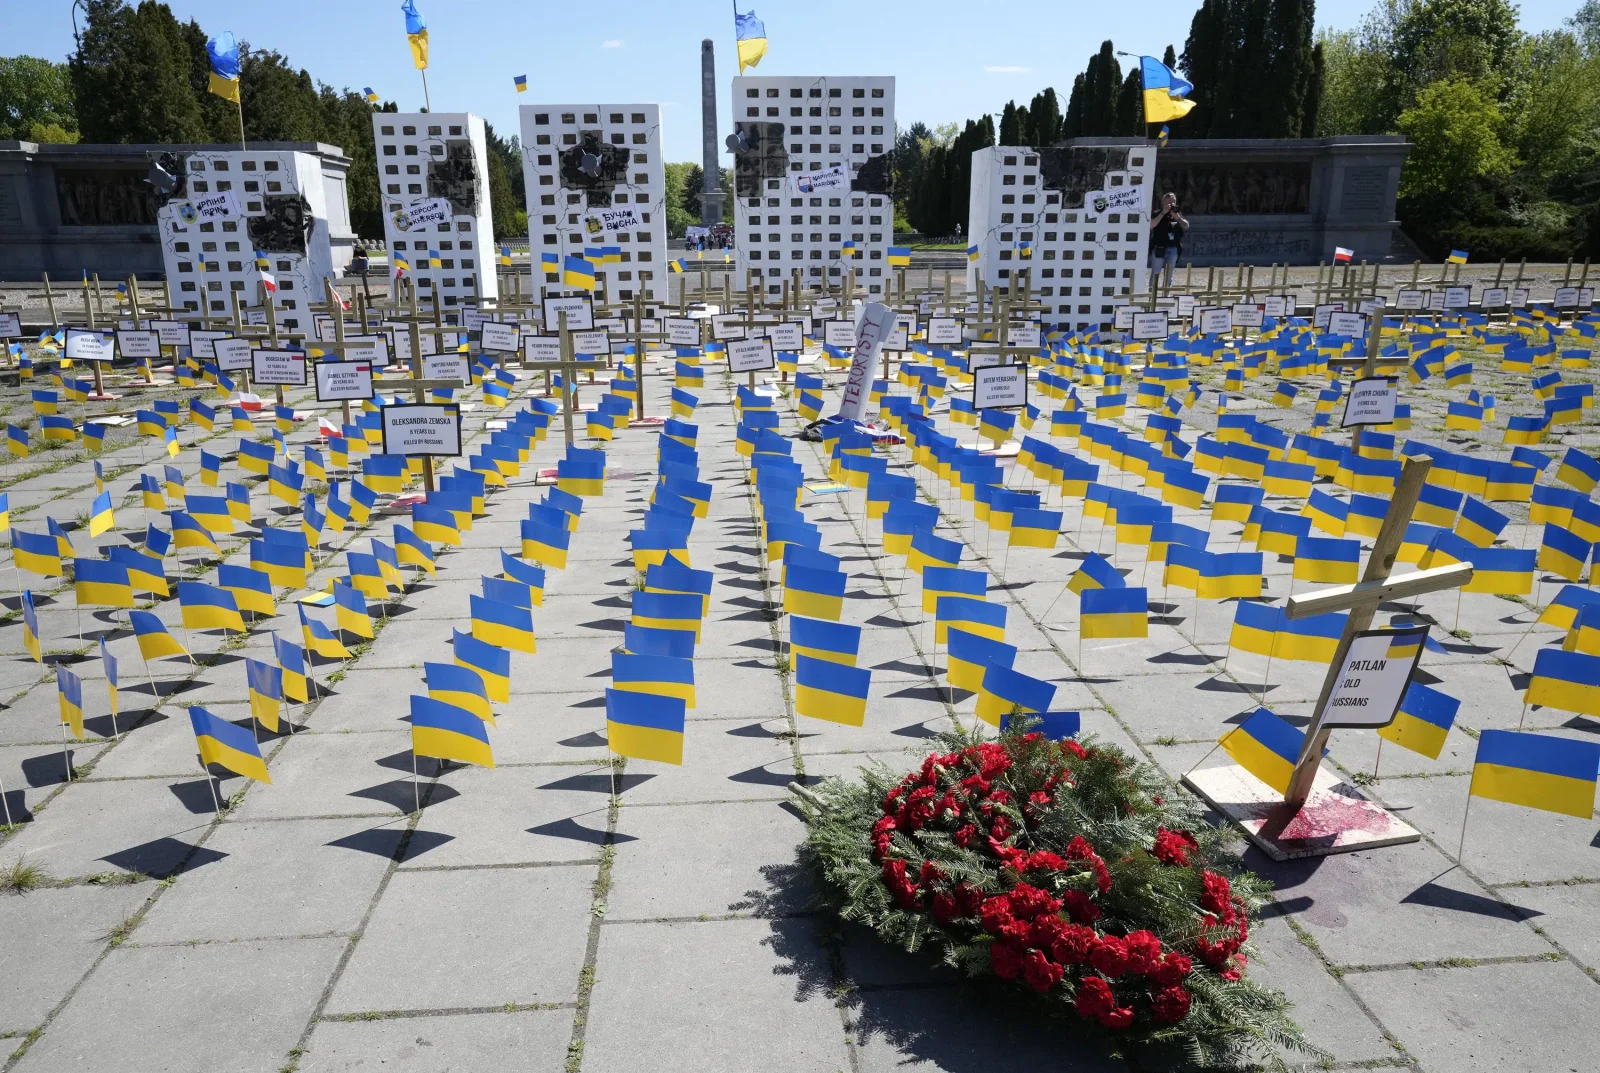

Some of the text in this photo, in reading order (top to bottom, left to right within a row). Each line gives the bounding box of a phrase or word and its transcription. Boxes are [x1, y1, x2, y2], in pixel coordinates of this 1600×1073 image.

[1109, 191, 1135, 201] БАХМУТ
[201, 206, 224, 217] IRPIN
[410, 204, 438, 217] ХЕРСОН
[412, 212, 445, 225] KHERSON
[844, 317, 881, 406] TERORYSTY
[391, 417, 451, 426] OLEKSANDRA ZEMSKA
[1348, 660, 1387, 672] PATLAN
[1343, 678, 1361, 688] OLD
